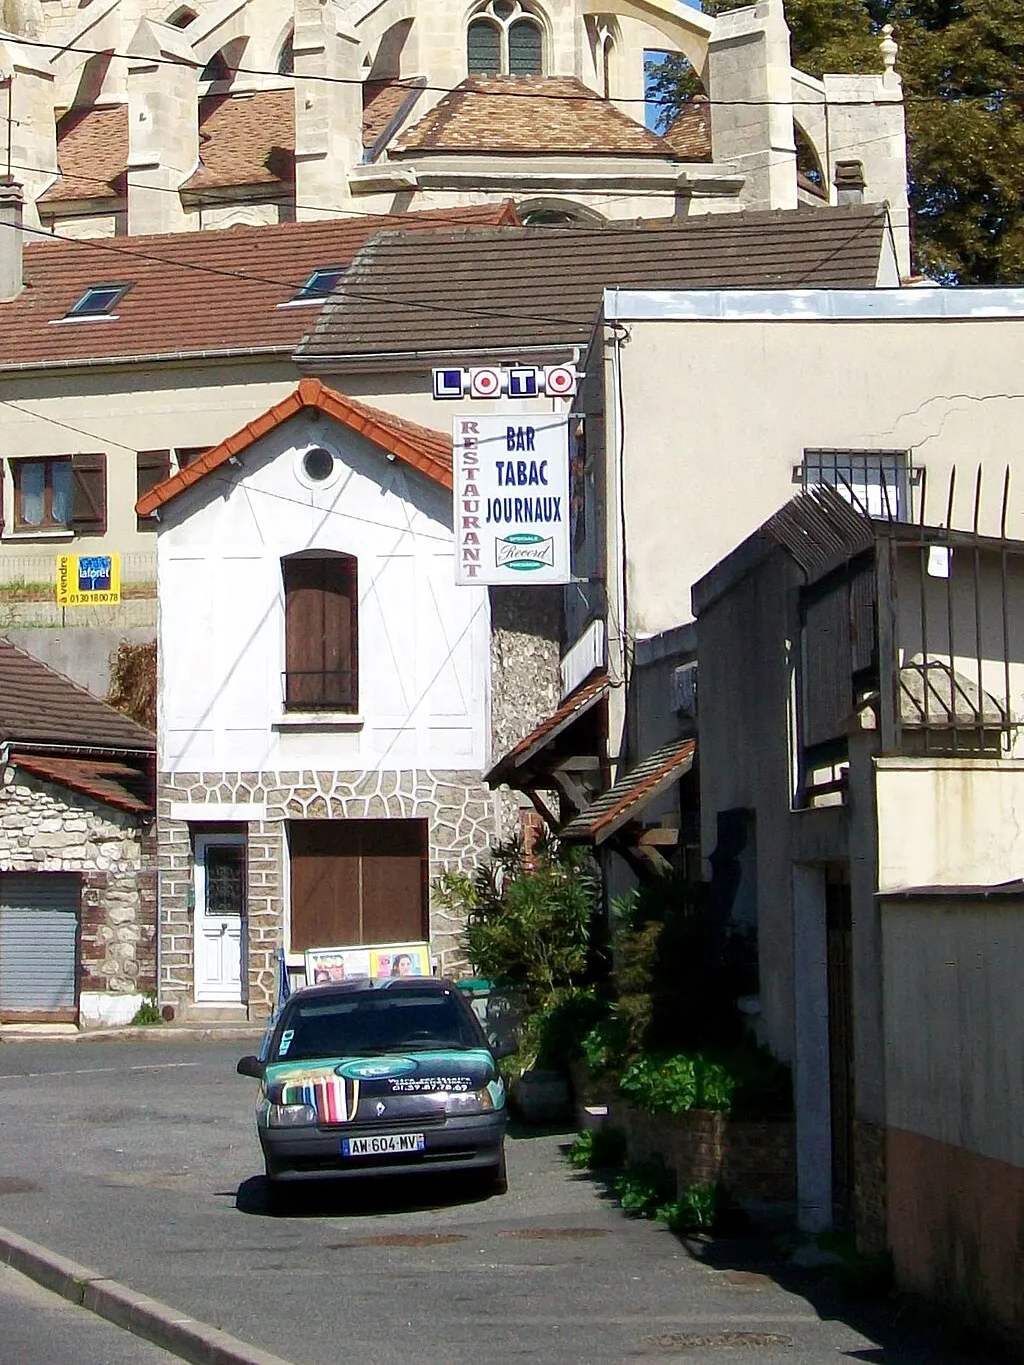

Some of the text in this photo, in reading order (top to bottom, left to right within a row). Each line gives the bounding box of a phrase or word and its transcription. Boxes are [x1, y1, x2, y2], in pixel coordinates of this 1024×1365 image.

[437, 367, 574, 395] LOTO
[506, 426, 535, 452] BAR
[496, 460, 548, 486] TABAC
[461, 421, 481, 577] RESTAURANT
[486, 497, 561, 523] JOURNAUX
[498, 544, 550, 561] Record
[58, 556, 68, 595] vendre
